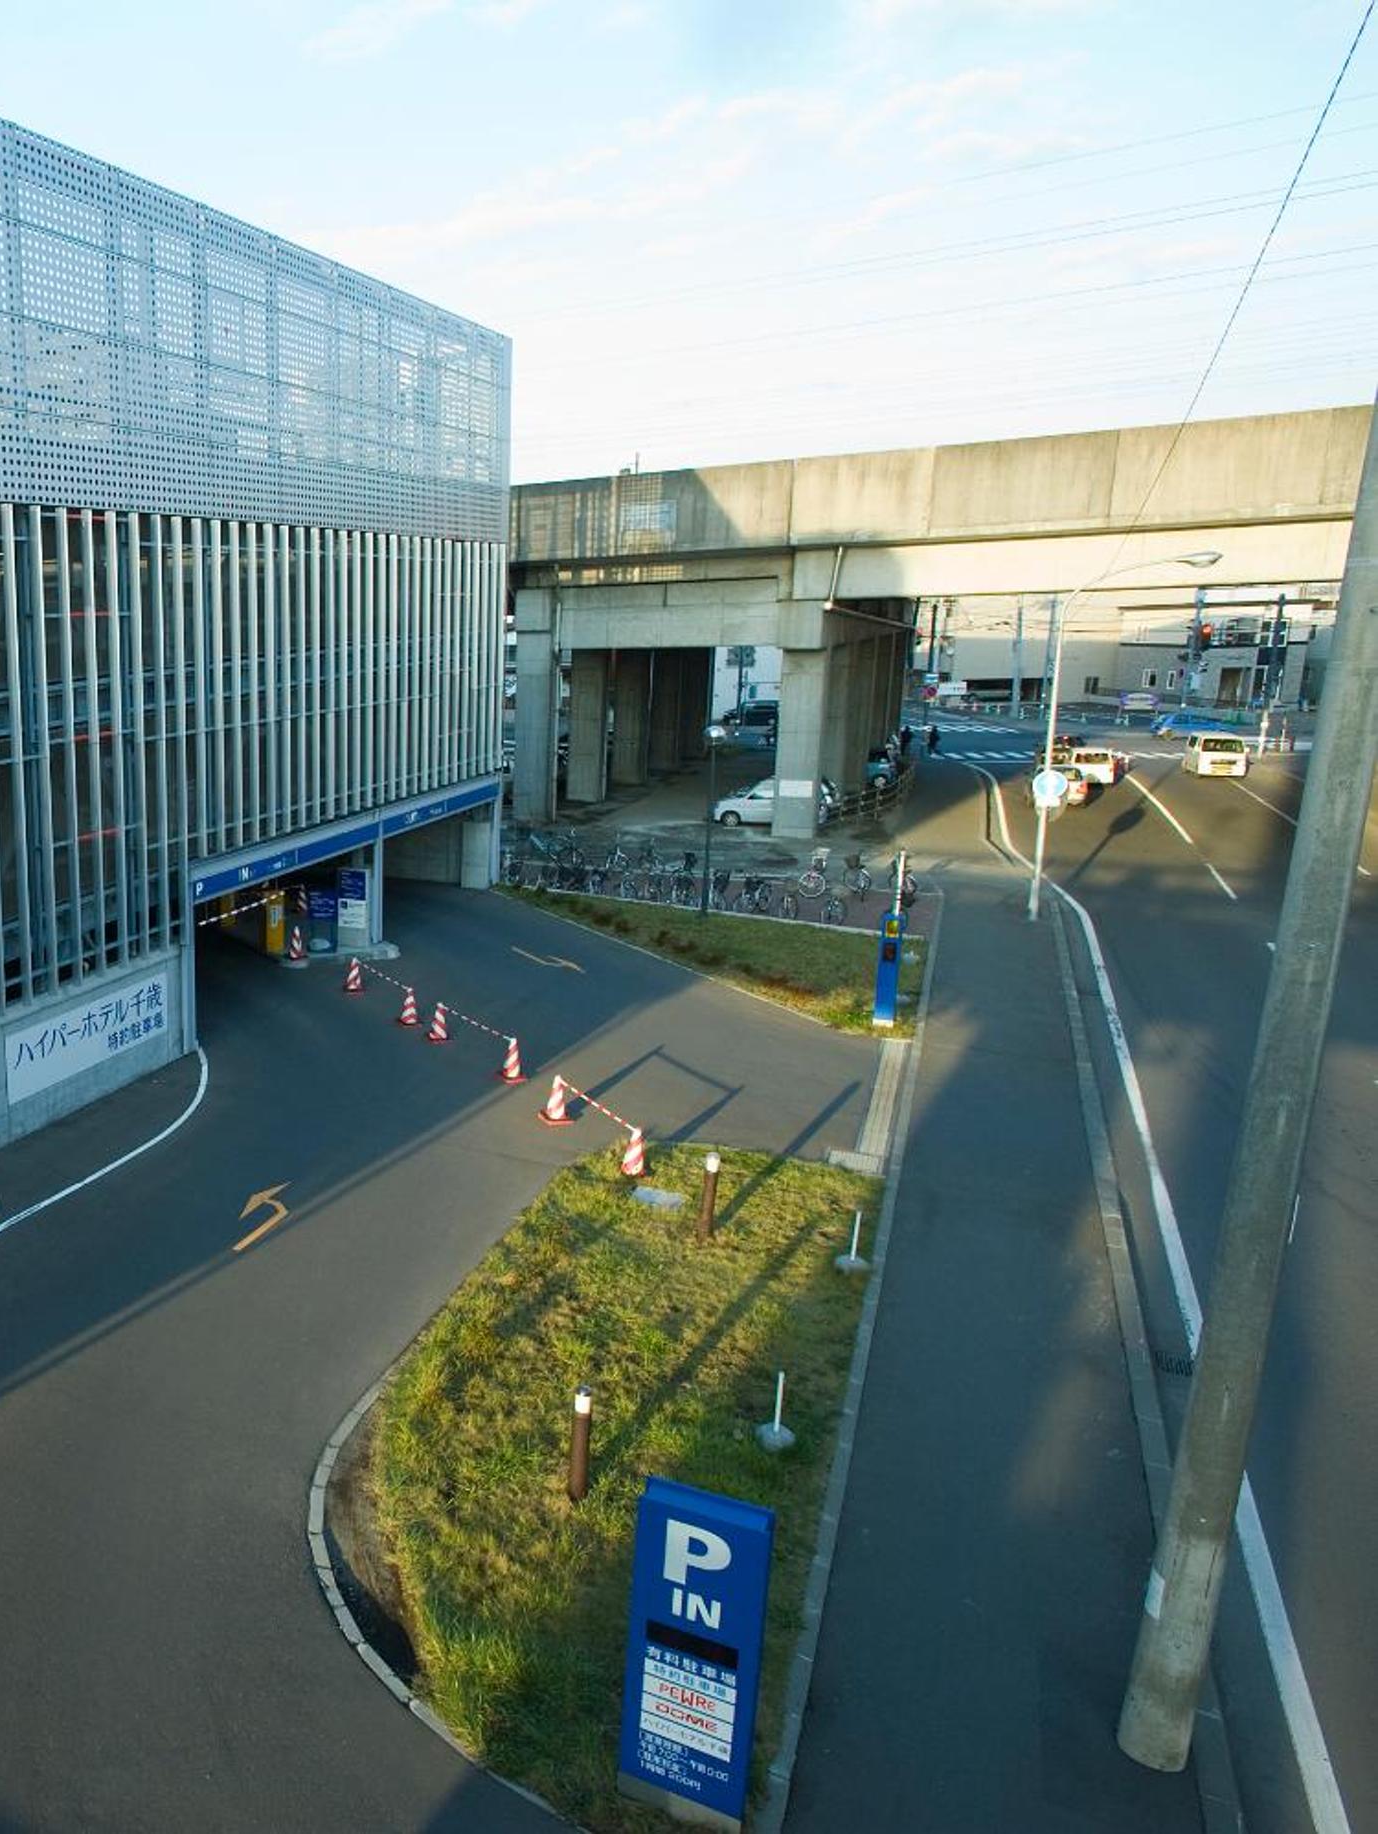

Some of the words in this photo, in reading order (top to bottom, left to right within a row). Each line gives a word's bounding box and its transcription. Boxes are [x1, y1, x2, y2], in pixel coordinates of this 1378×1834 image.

[195, 882, 204, 897] P
[14, 983, 163, 1070] ハイパーホテル千歳
[663, 1518, 732, 1585] P
[672, 1588, 722, 1630] IN
[647, 1646, 737, 1687] 有料駐車場
